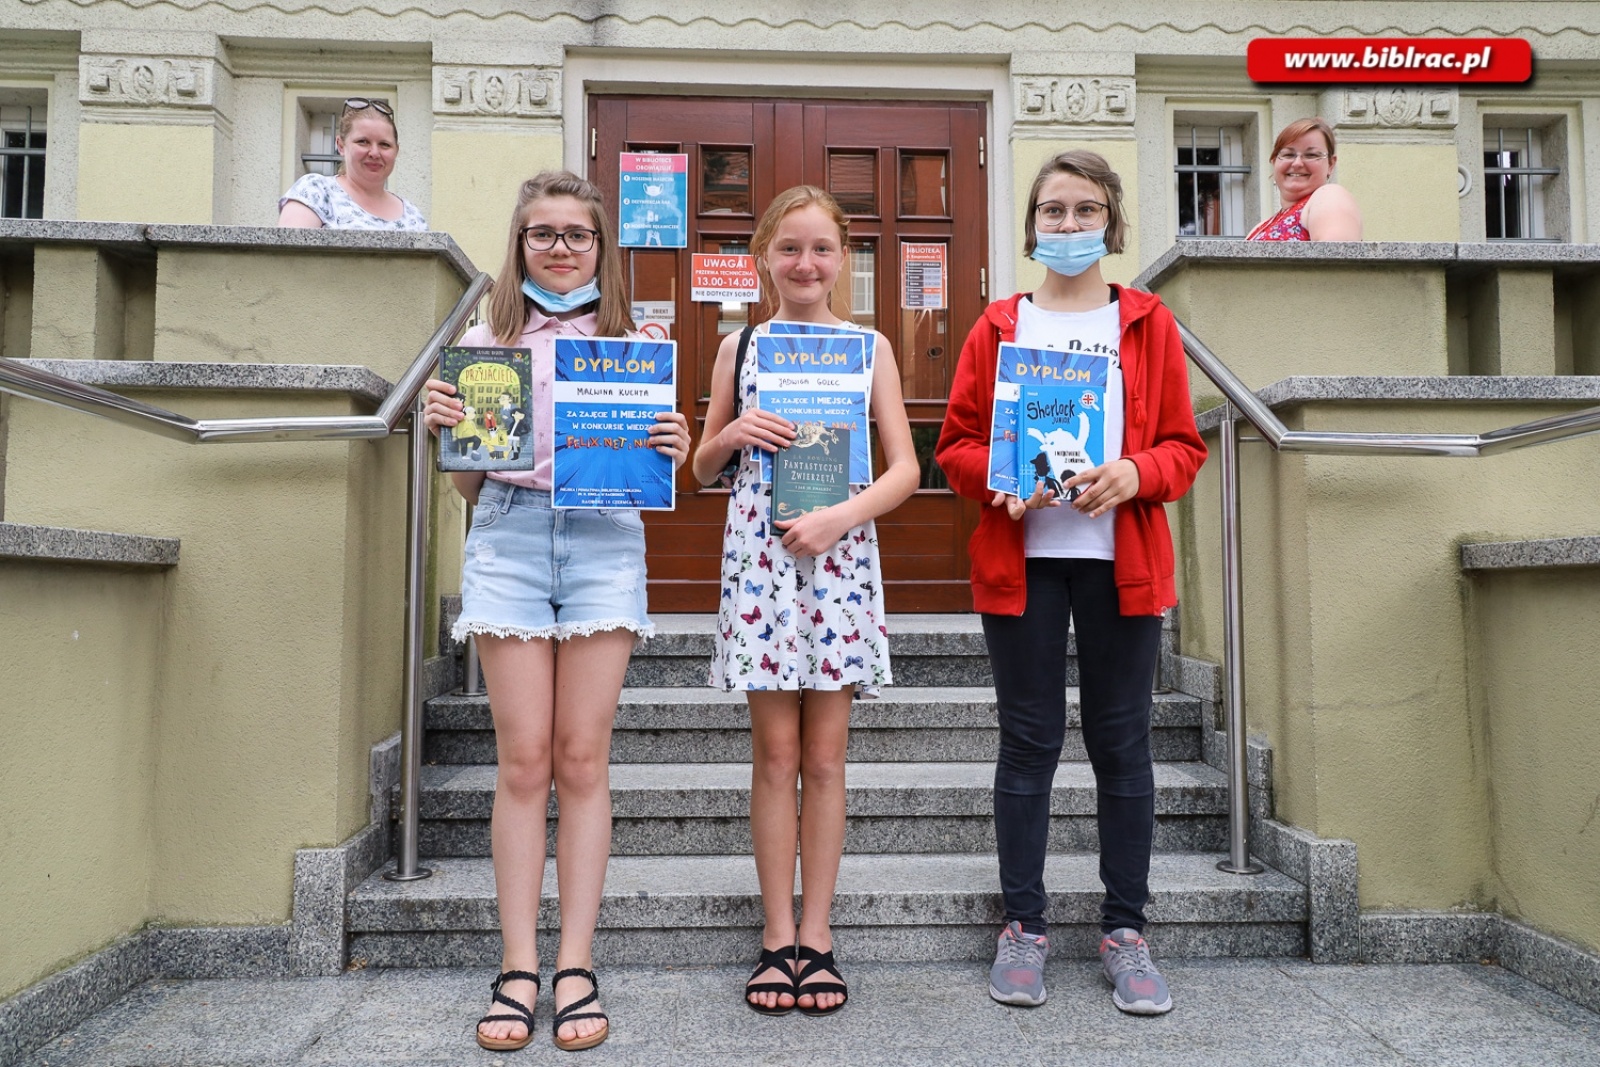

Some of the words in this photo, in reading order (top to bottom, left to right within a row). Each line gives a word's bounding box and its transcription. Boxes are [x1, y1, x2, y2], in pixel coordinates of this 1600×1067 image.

[703, 258, 747, 269] UWAGA!
[697, 276, 755, 287] 13.00-14.00
[773, 352, 847, 366] DYPLOM
[573, 357, 656, 374] DYPLOM
[465, 368, 514, 384] PRZYJACIELE
[1015, 362, 1091, 383] DYPLOM
[619, 388, 649, 397] KUCHTA
[783, 397, 808, 405] ZAJĘCIE
[817, 396, 852, 405] MIEJSCA
[566, 410, 577, 418] ZA
[580, 411, 608, 420] ZAJĘCIE
[611, 410, 617, 418] II
[1004, 407, 1014, 415] ZA
[1026, 398, 1076, 420] Sherlock
[572, 422, 579, 430] W
[581, 422, 624, 431] KONKURSIE
[604, 436, 627, 450] NET
[807, 455, 837, 463] ROWLING
[784, 459, 844, 474] FANTASTYCZNE
[791, 470, 835, 484] ZWIERZĘTA
